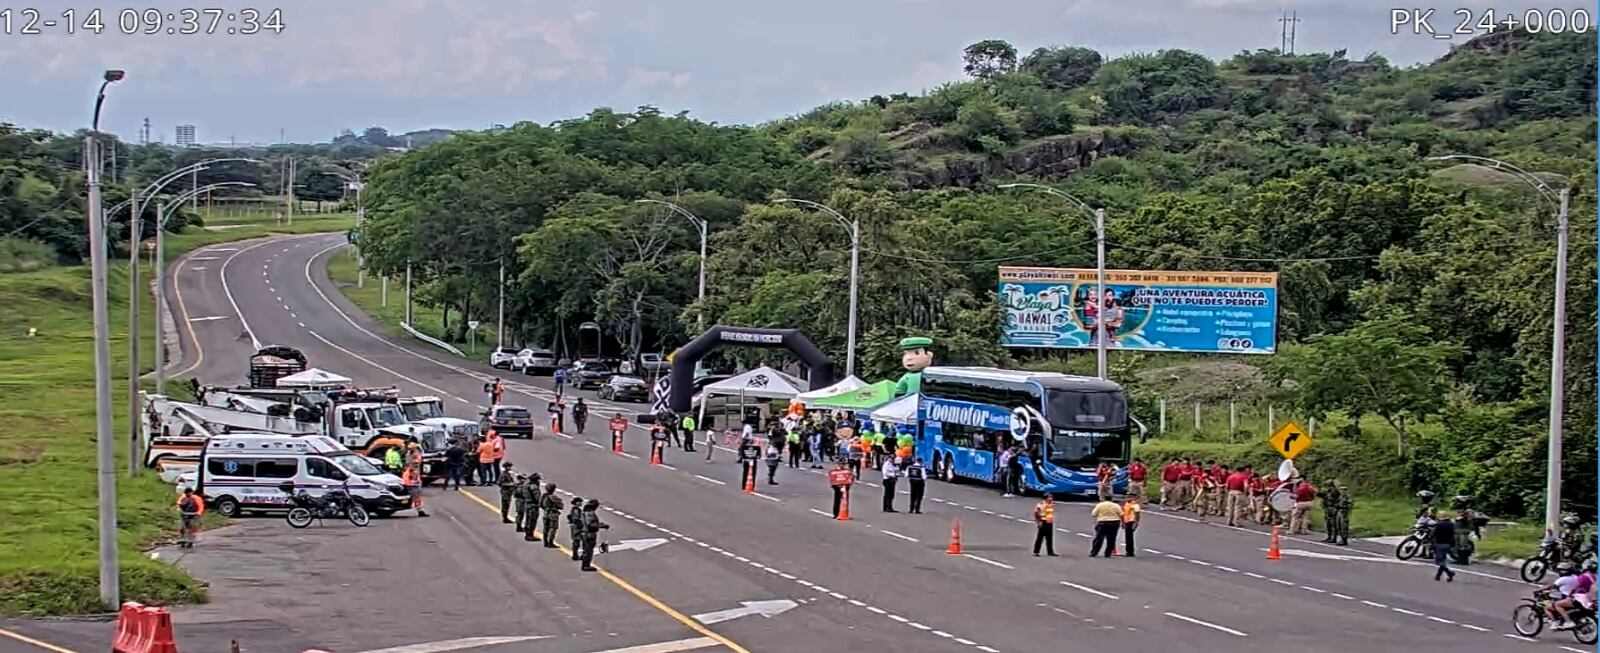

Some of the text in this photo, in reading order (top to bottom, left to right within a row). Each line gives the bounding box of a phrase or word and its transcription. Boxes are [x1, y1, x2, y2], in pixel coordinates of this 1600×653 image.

[1163, 289, 1214, 298] AVENTURA
[1216, 288, 1265, 299] ACUÁTICA
[1016, 296, 1053, 312] Playa
[1132, 297, 1154, 305] QUE
[1156, 297, 1171, 305] NO
[1185, 298, 1223, 306] PUEDES
[1018, 312, 1051, 325] HAWAI
[925, 400, 990, 428] Coomotor
